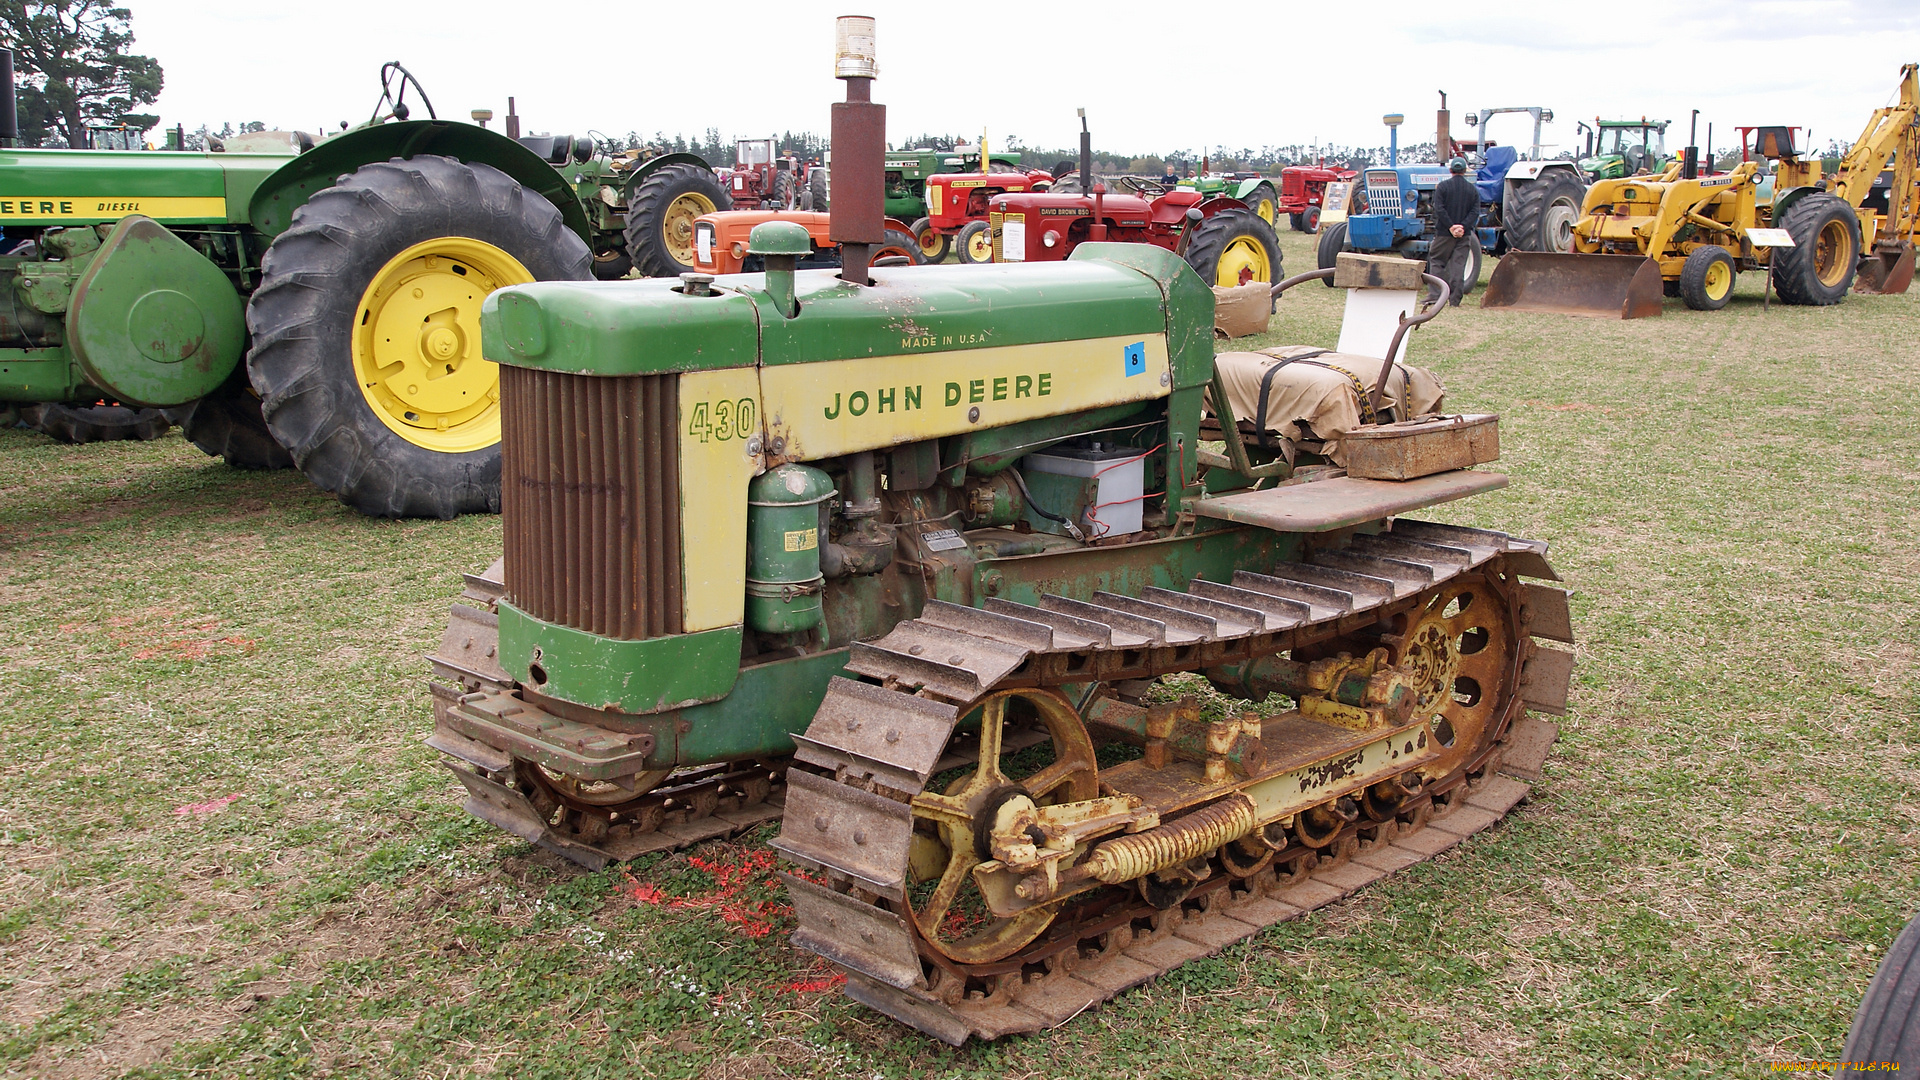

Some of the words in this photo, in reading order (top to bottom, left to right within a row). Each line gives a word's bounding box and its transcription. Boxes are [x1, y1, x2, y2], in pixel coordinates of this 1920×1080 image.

[97, 203, 140, 211] DIESEL
[902, 336, 937, 349] MADE
[942, 335, 953, 346] IN
[1131, 353, 1139, 366] 8
[824, 384, 923, 421] JOHN
[945, 372, 1052, 408] DEERE
[689, 397, 755, 443] 430
